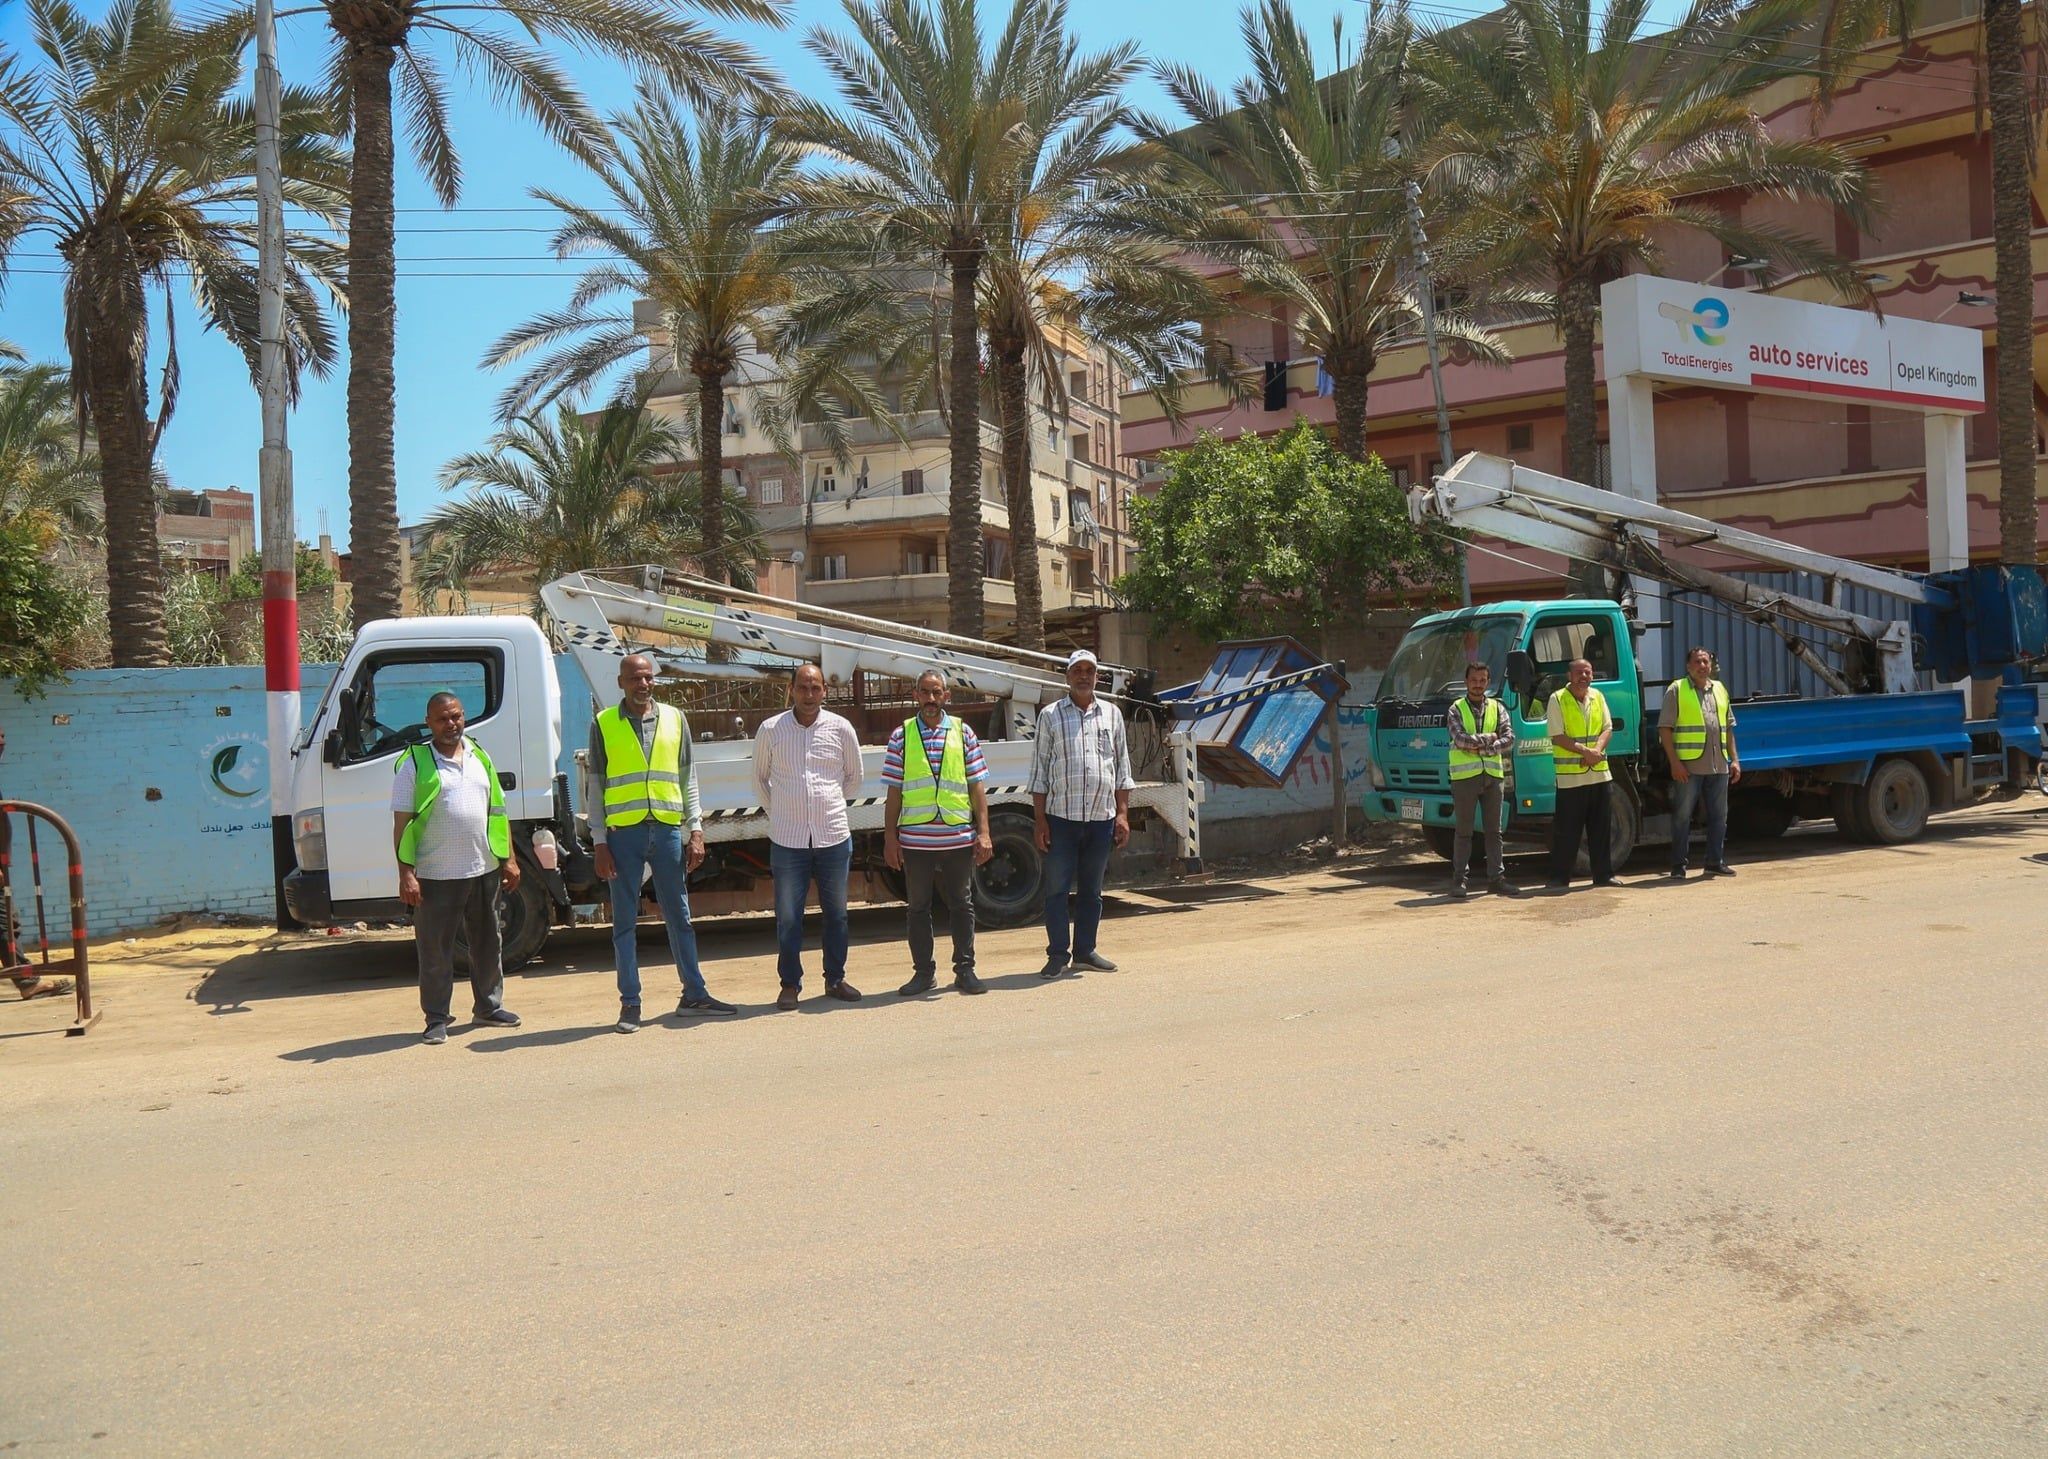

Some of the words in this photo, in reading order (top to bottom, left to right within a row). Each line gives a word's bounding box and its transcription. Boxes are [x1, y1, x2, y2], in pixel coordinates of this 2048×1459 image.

[1661, 351, 1733, 373] TotalEnergies
[1749, 344, 1792, 366] auto
[1796, 352, 1868, 376] services
[1897, 362, 1925, 382] Opel
[1928, 366, 1977, 388] Kingdom
[1398, 714, 1445, 728] CHEVROLET
